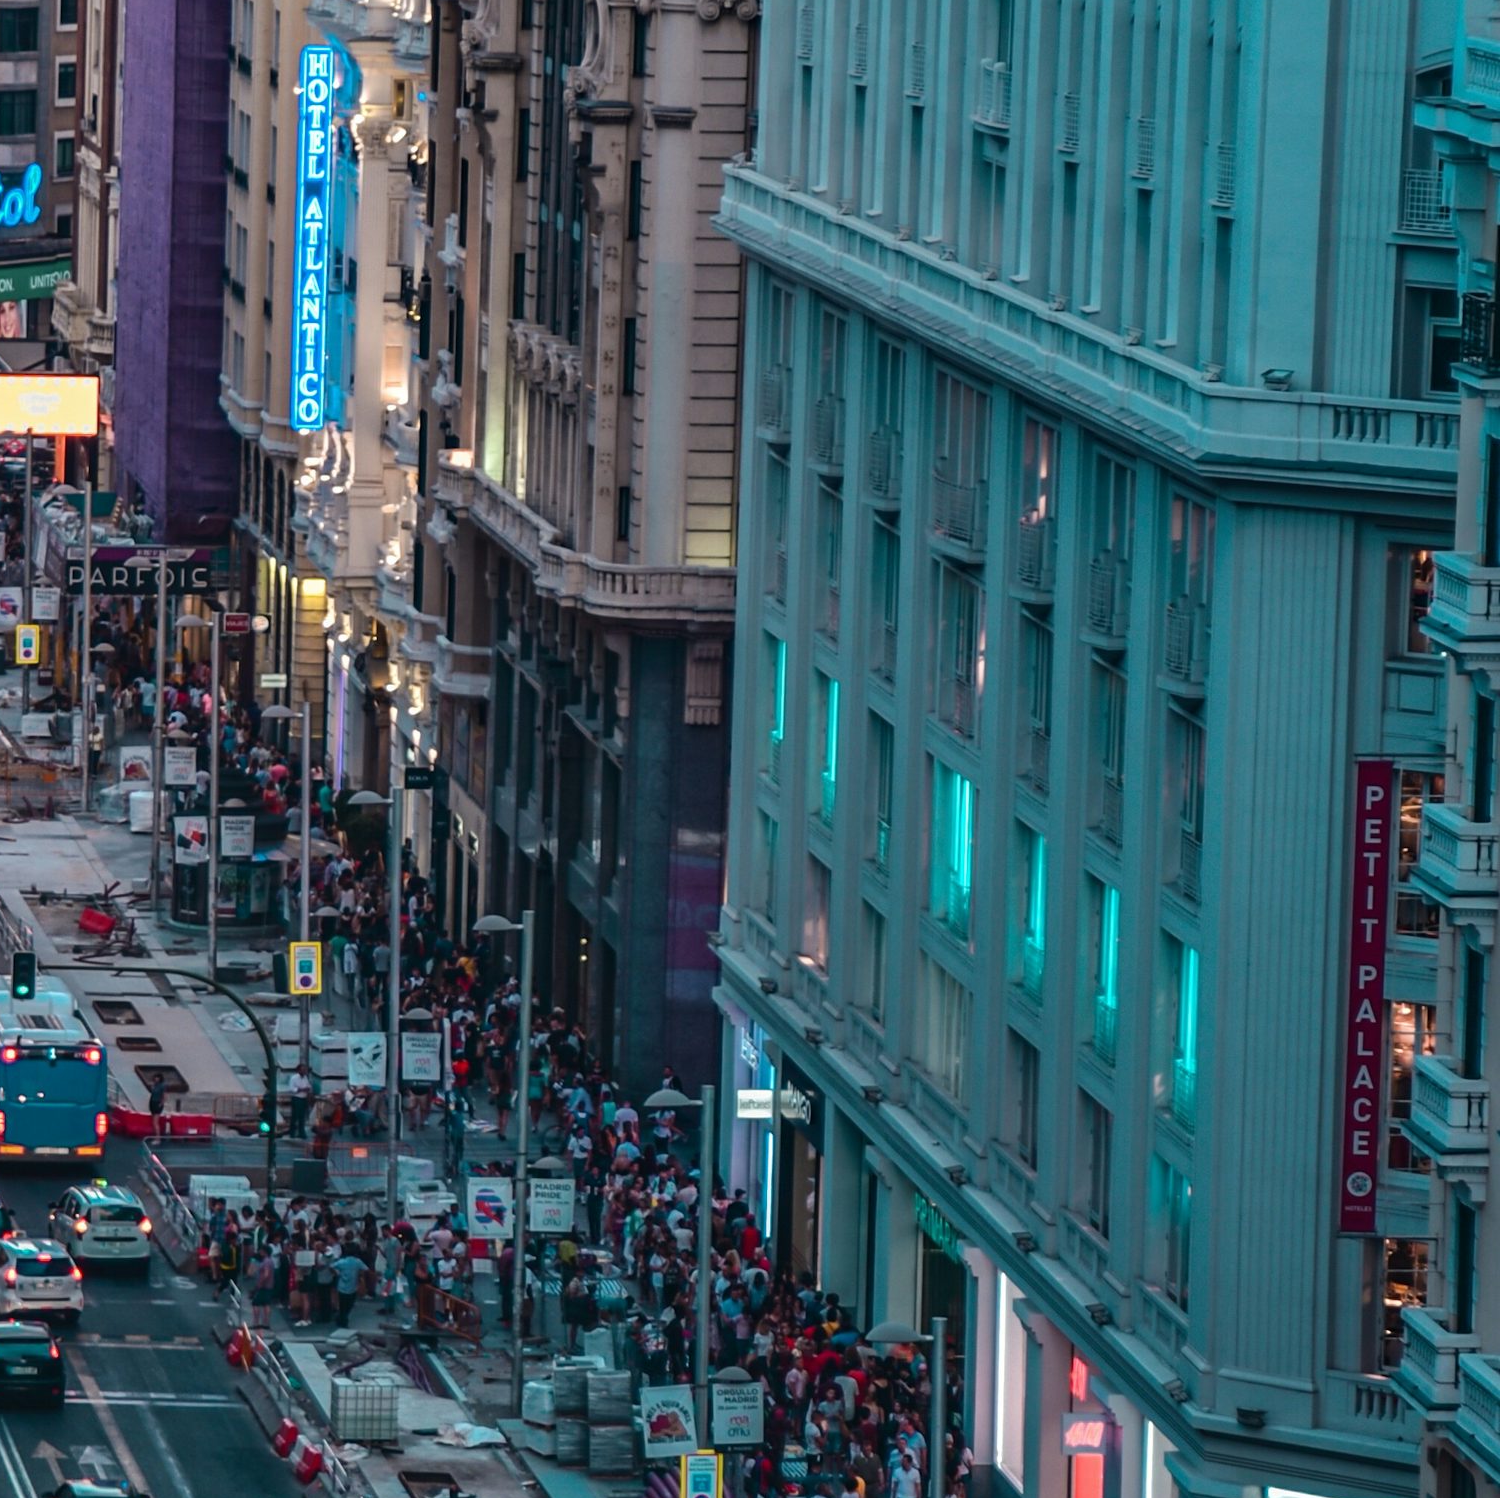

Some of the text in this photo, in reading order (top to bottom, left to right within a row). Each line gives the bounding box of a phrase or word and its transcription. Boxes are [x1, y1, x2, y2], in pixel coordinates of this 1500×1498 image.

[298, 53, 329, 422] HOTEL ATLANTICO
[69, 567, 208, 589] PARFOIS
[1352, 785, 1384, 1157] PETIT PALACE
[50, 1047, 56, 1059] 1
[534, 1183, 571, 1191] MADRID
[534, 1191, 562, 1199] PRIDE
[716, 1388, 758, 1396] ORGULLO
